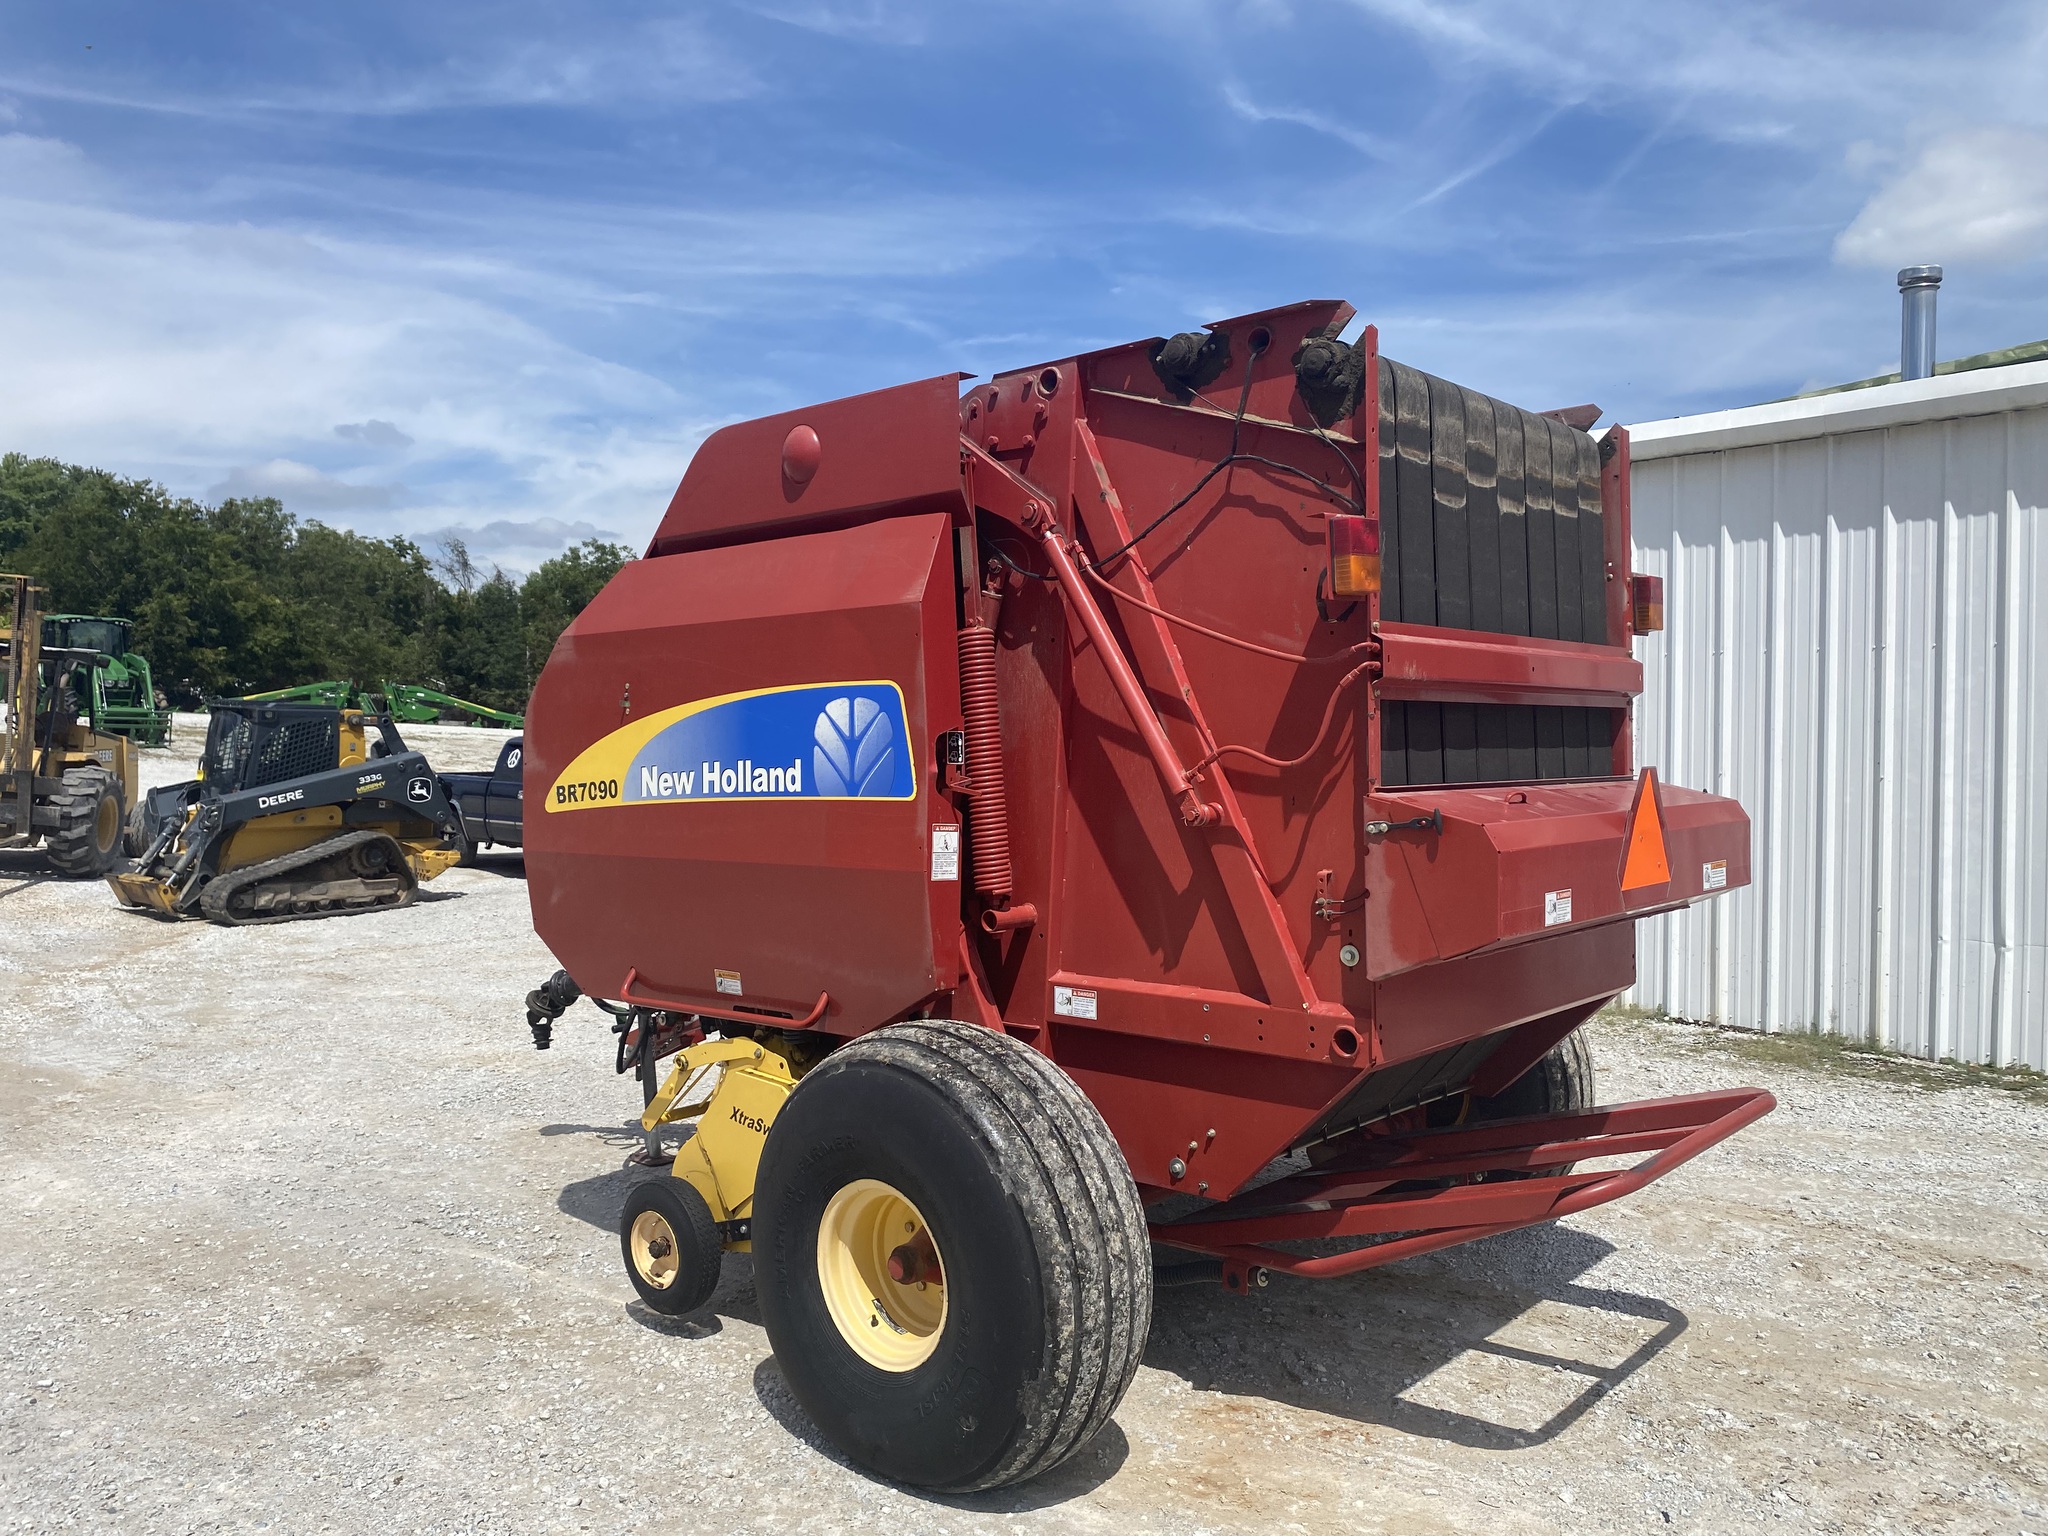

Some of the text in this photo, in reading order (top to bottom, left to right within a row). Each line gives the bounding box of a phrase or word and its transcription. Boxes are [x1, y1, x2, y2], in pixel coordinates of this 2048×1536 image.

[358, 773, 383, 785] 333G
[640, 758, 802, 798] New Holland
[258, 789, 305, 809] DEERE
[556, 779, 618, 804] BR7090
